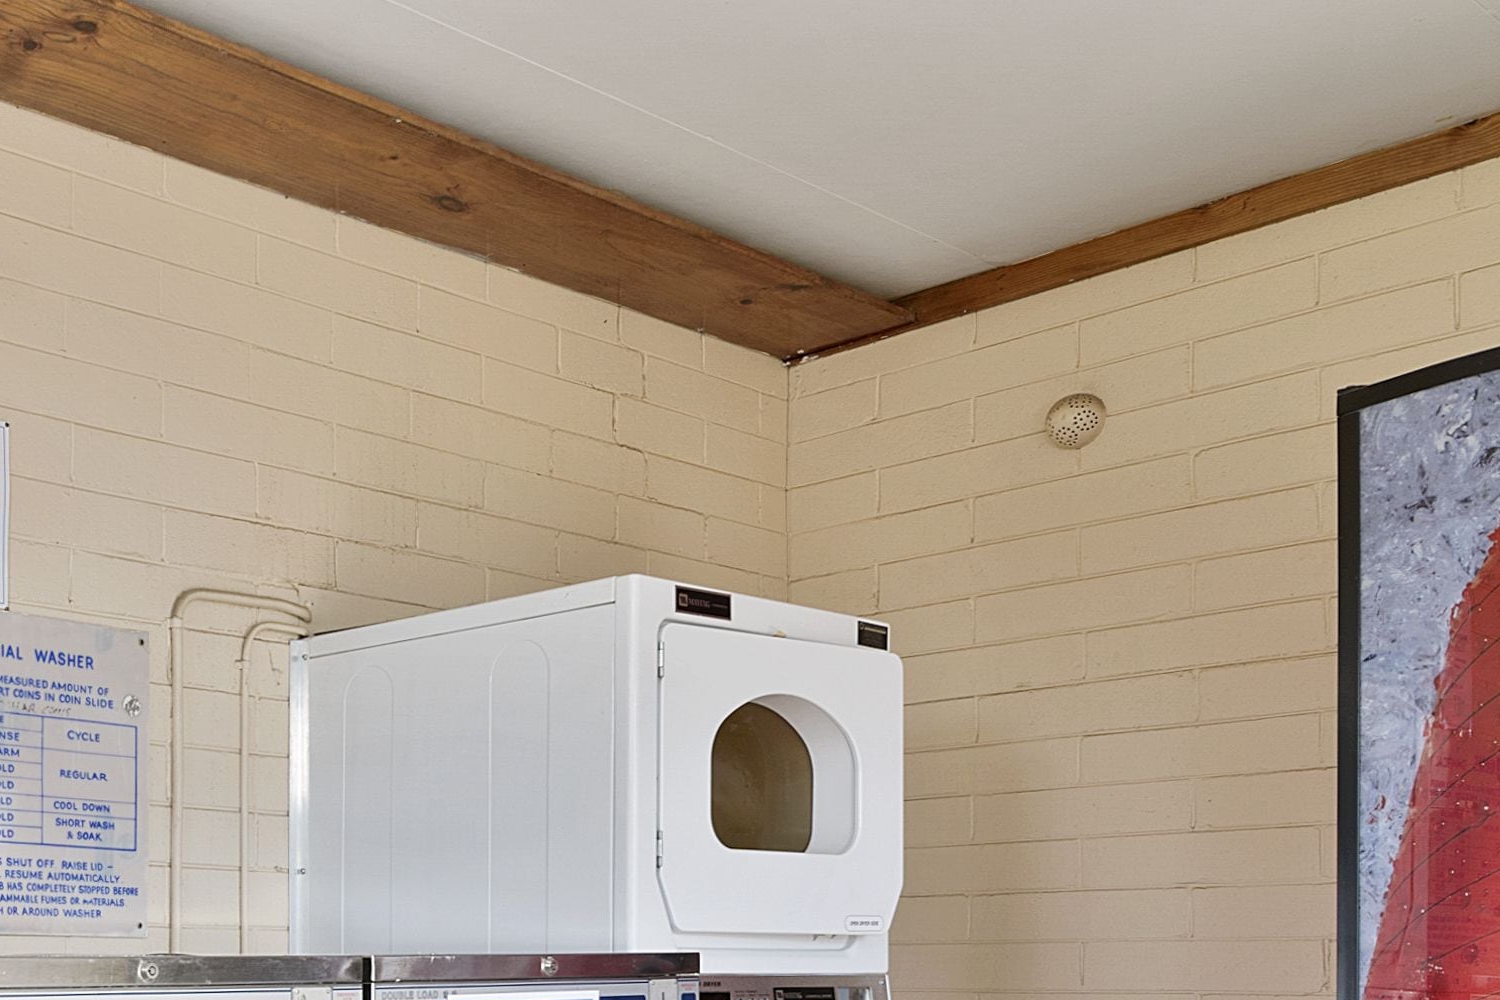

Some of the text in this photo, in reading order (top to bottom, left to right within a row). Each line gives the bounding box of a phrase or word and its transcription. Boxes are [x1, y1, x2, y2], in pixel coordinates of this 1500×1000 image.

[35, 650, 94, 670] WASHER
[51, 681, 92, 694] AMOUNT
[97, 687, 110, 696] OF
[13, 690, 41, 700] COINS
[59, 695, 81, 704] COIN
[85, 698, 114, 709] SLIDE
[67, 730, 100, 742] CYCLE
[60, 770, 108, 781] REGULAR
[54, 801, 110, 813] COOL DOWN
[56, 818, 115, 830] SHORT WASH
[77, 832, 102, 841] SOAK
[6, 857, 32, 867] SHUT
[62, 861, 87, 871] RAISE
[91, 863, 103, 871] LID
[5, 871, 43, 880] RESUME
[8, 882, 22, 891] HAS
[27, 883, 76, 893] COMPLETELY
[79, 886, 110, 894] STOPPED
[113, 887, 139, 896] BEFORE
[41, 895, 67, 904] FUMES
[70, 897, 79, 905] OR
[7, 906, 18, 915] OR
[22, 907, 58, 917] AROUND
[63, 909, 101, 918] WASHER
[382, 990, 438, 999] DOUBLE LOAD
